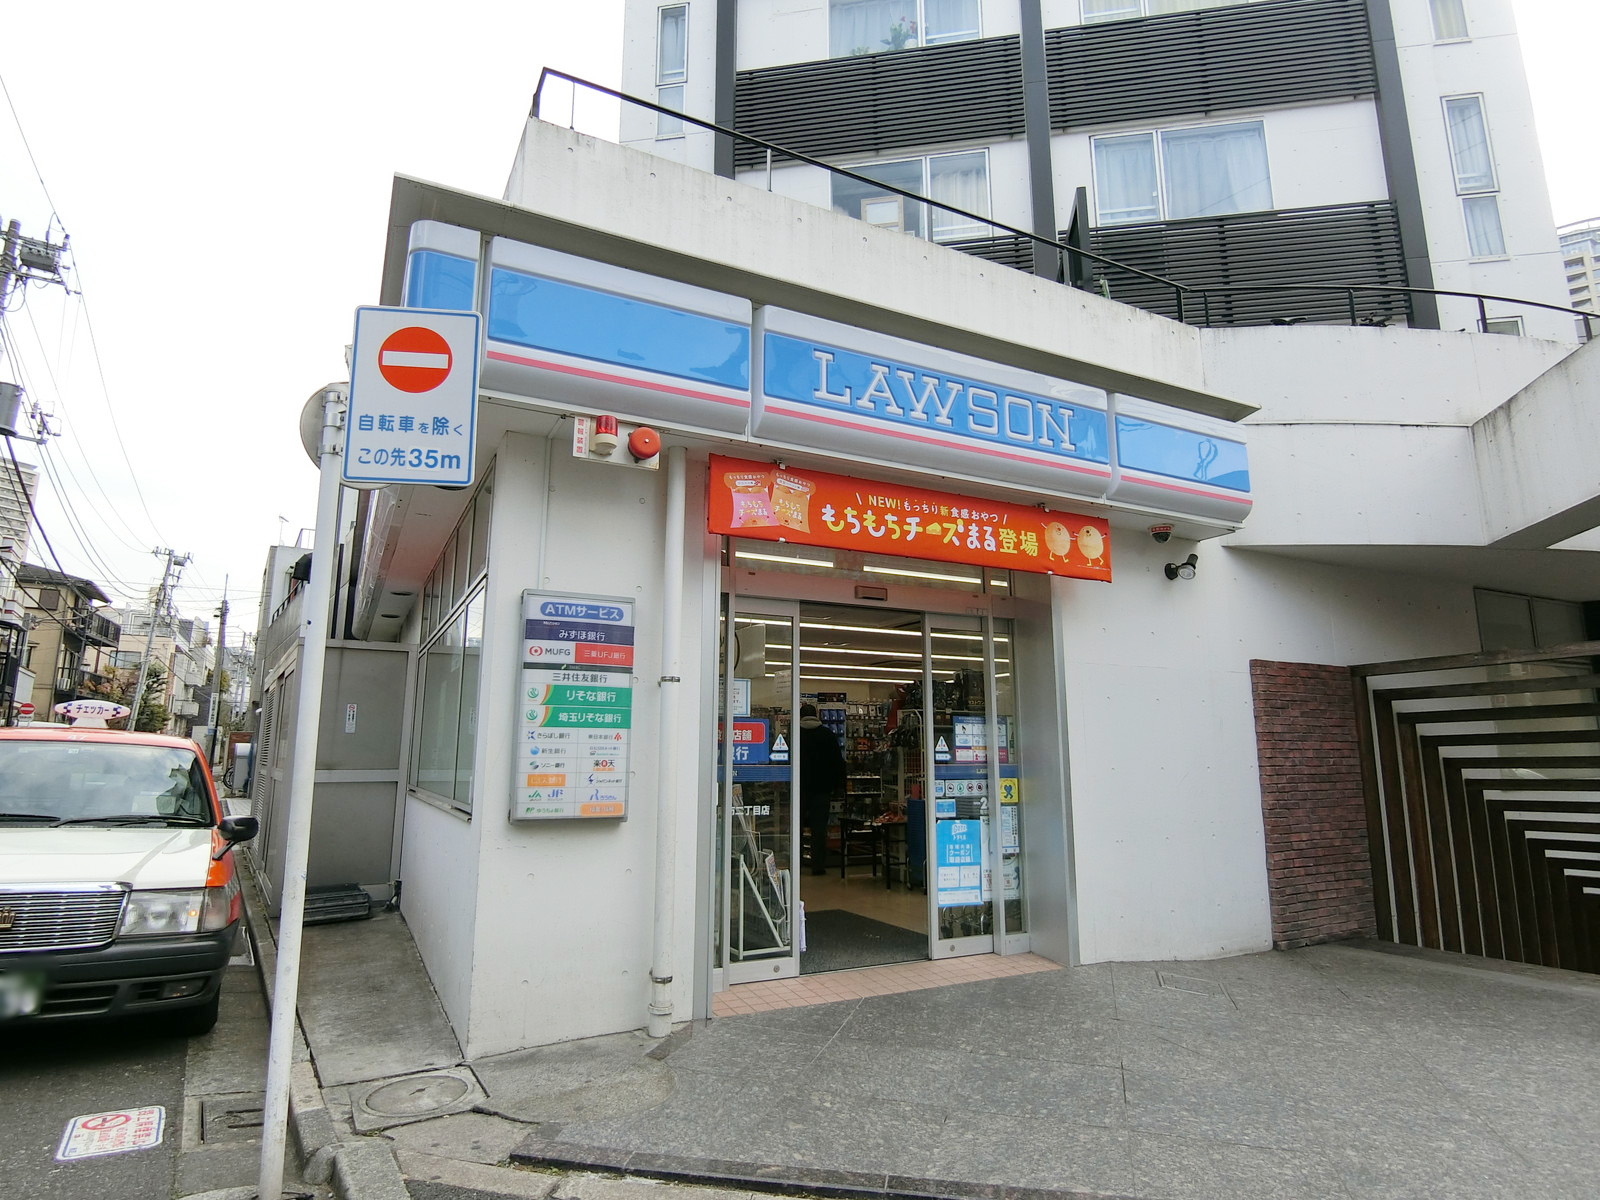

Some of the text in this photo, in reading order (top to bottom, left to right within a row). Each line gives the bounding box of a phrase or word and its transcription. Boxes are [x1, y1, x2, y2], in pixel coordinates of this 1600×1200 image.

[812, 348, 1077, 454] LAWSON
[358, 413, 463, 437] 自転車を除く
[357, 446, 461, 470] この先35m
[740, 500, 764, 508] もちもち
[868, 494, 999, 523] NEW! もっちり新食感おやつ
[545, 603, 620, 620] ATMサービス
[559, 629, 606, 642] みずほ銀行
[544, 648, 571, 656] MUFG
[584, 650, 626, 660] 三菱UFJ銀行
[552, 672, 608, 683] 三井住友銀行
[566, 690, 617, 703] りそな銀行
[76, 704, 110, 715] チェッカー
[558, 711, 622, 723] 埼玉りそな銀行
